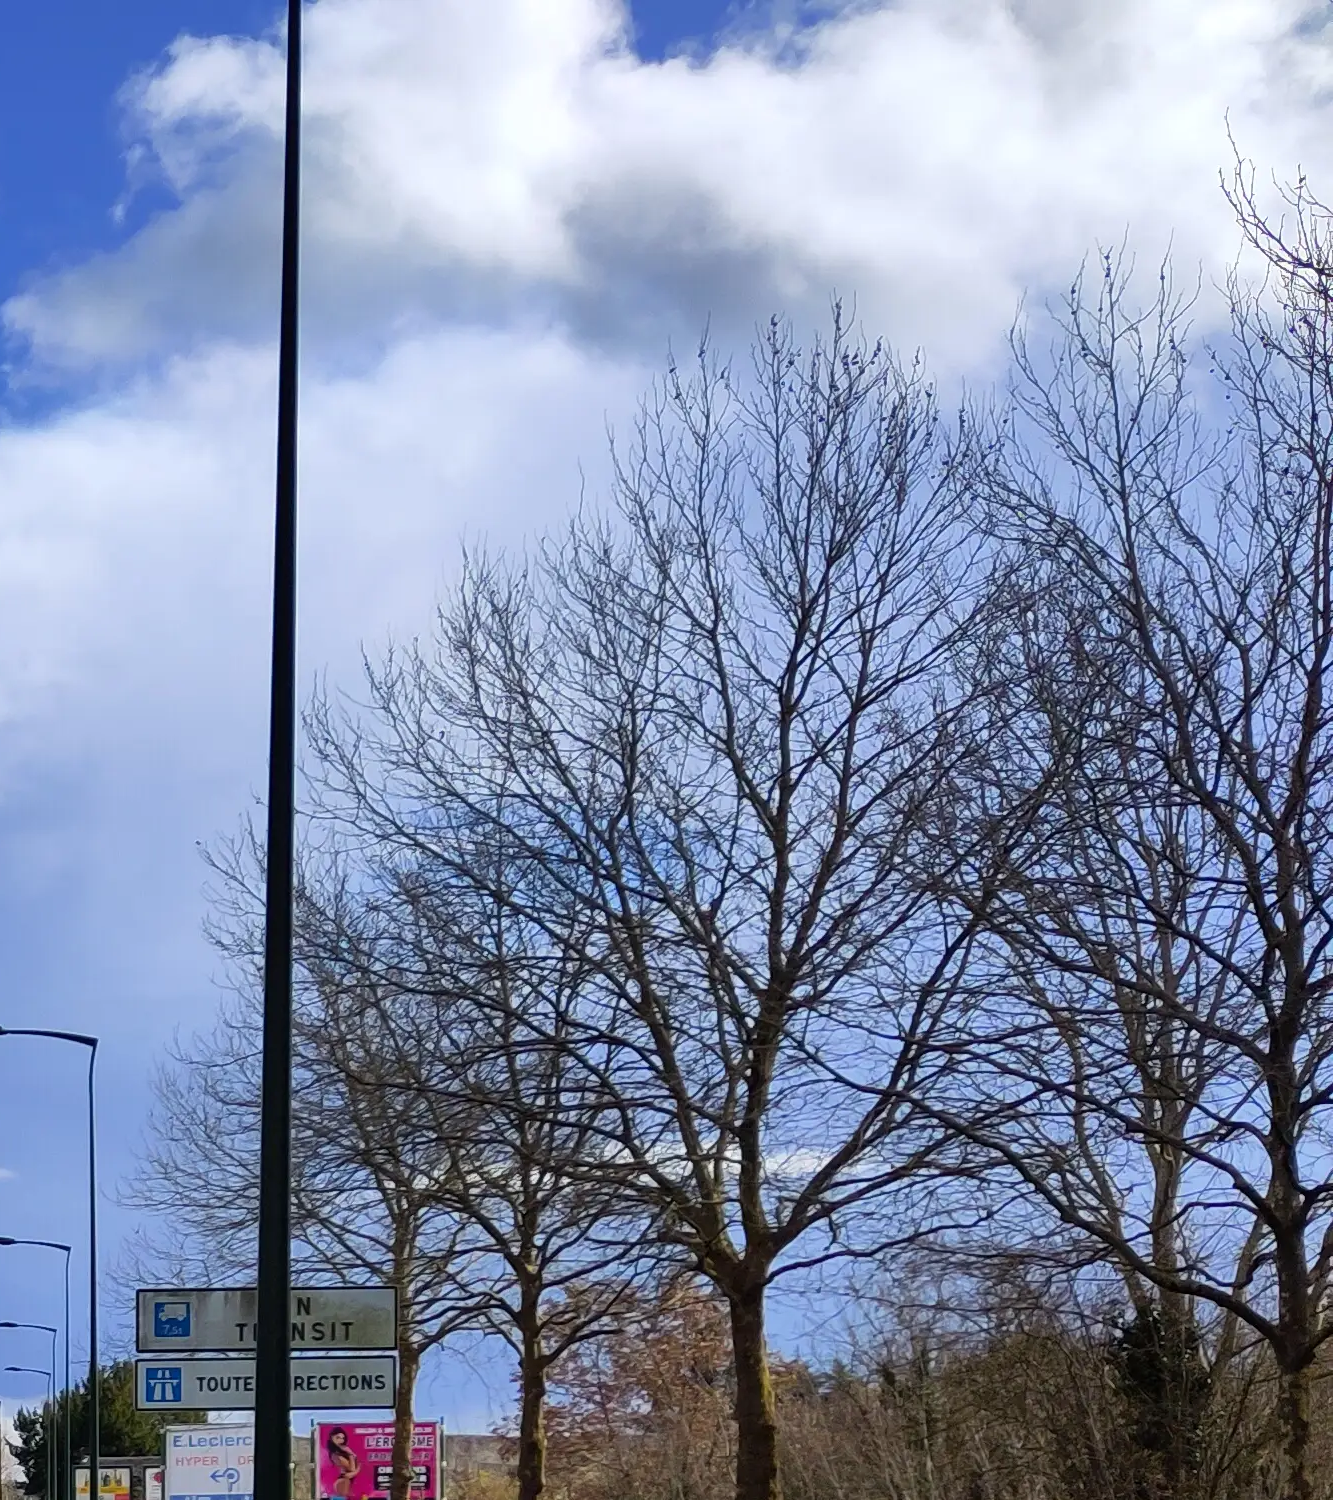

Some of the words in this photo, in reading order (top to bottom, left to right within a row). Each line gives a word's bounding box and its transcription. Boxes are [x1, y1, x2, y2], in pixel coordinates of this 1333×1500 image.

[234, 1321, 355, 1343] TNSIT
[196, 1375, 254, 1393] TOUTE
[292, 1373, 386, 1391] RECTIONS
[175, 1456, 220, 1467] HYPER
